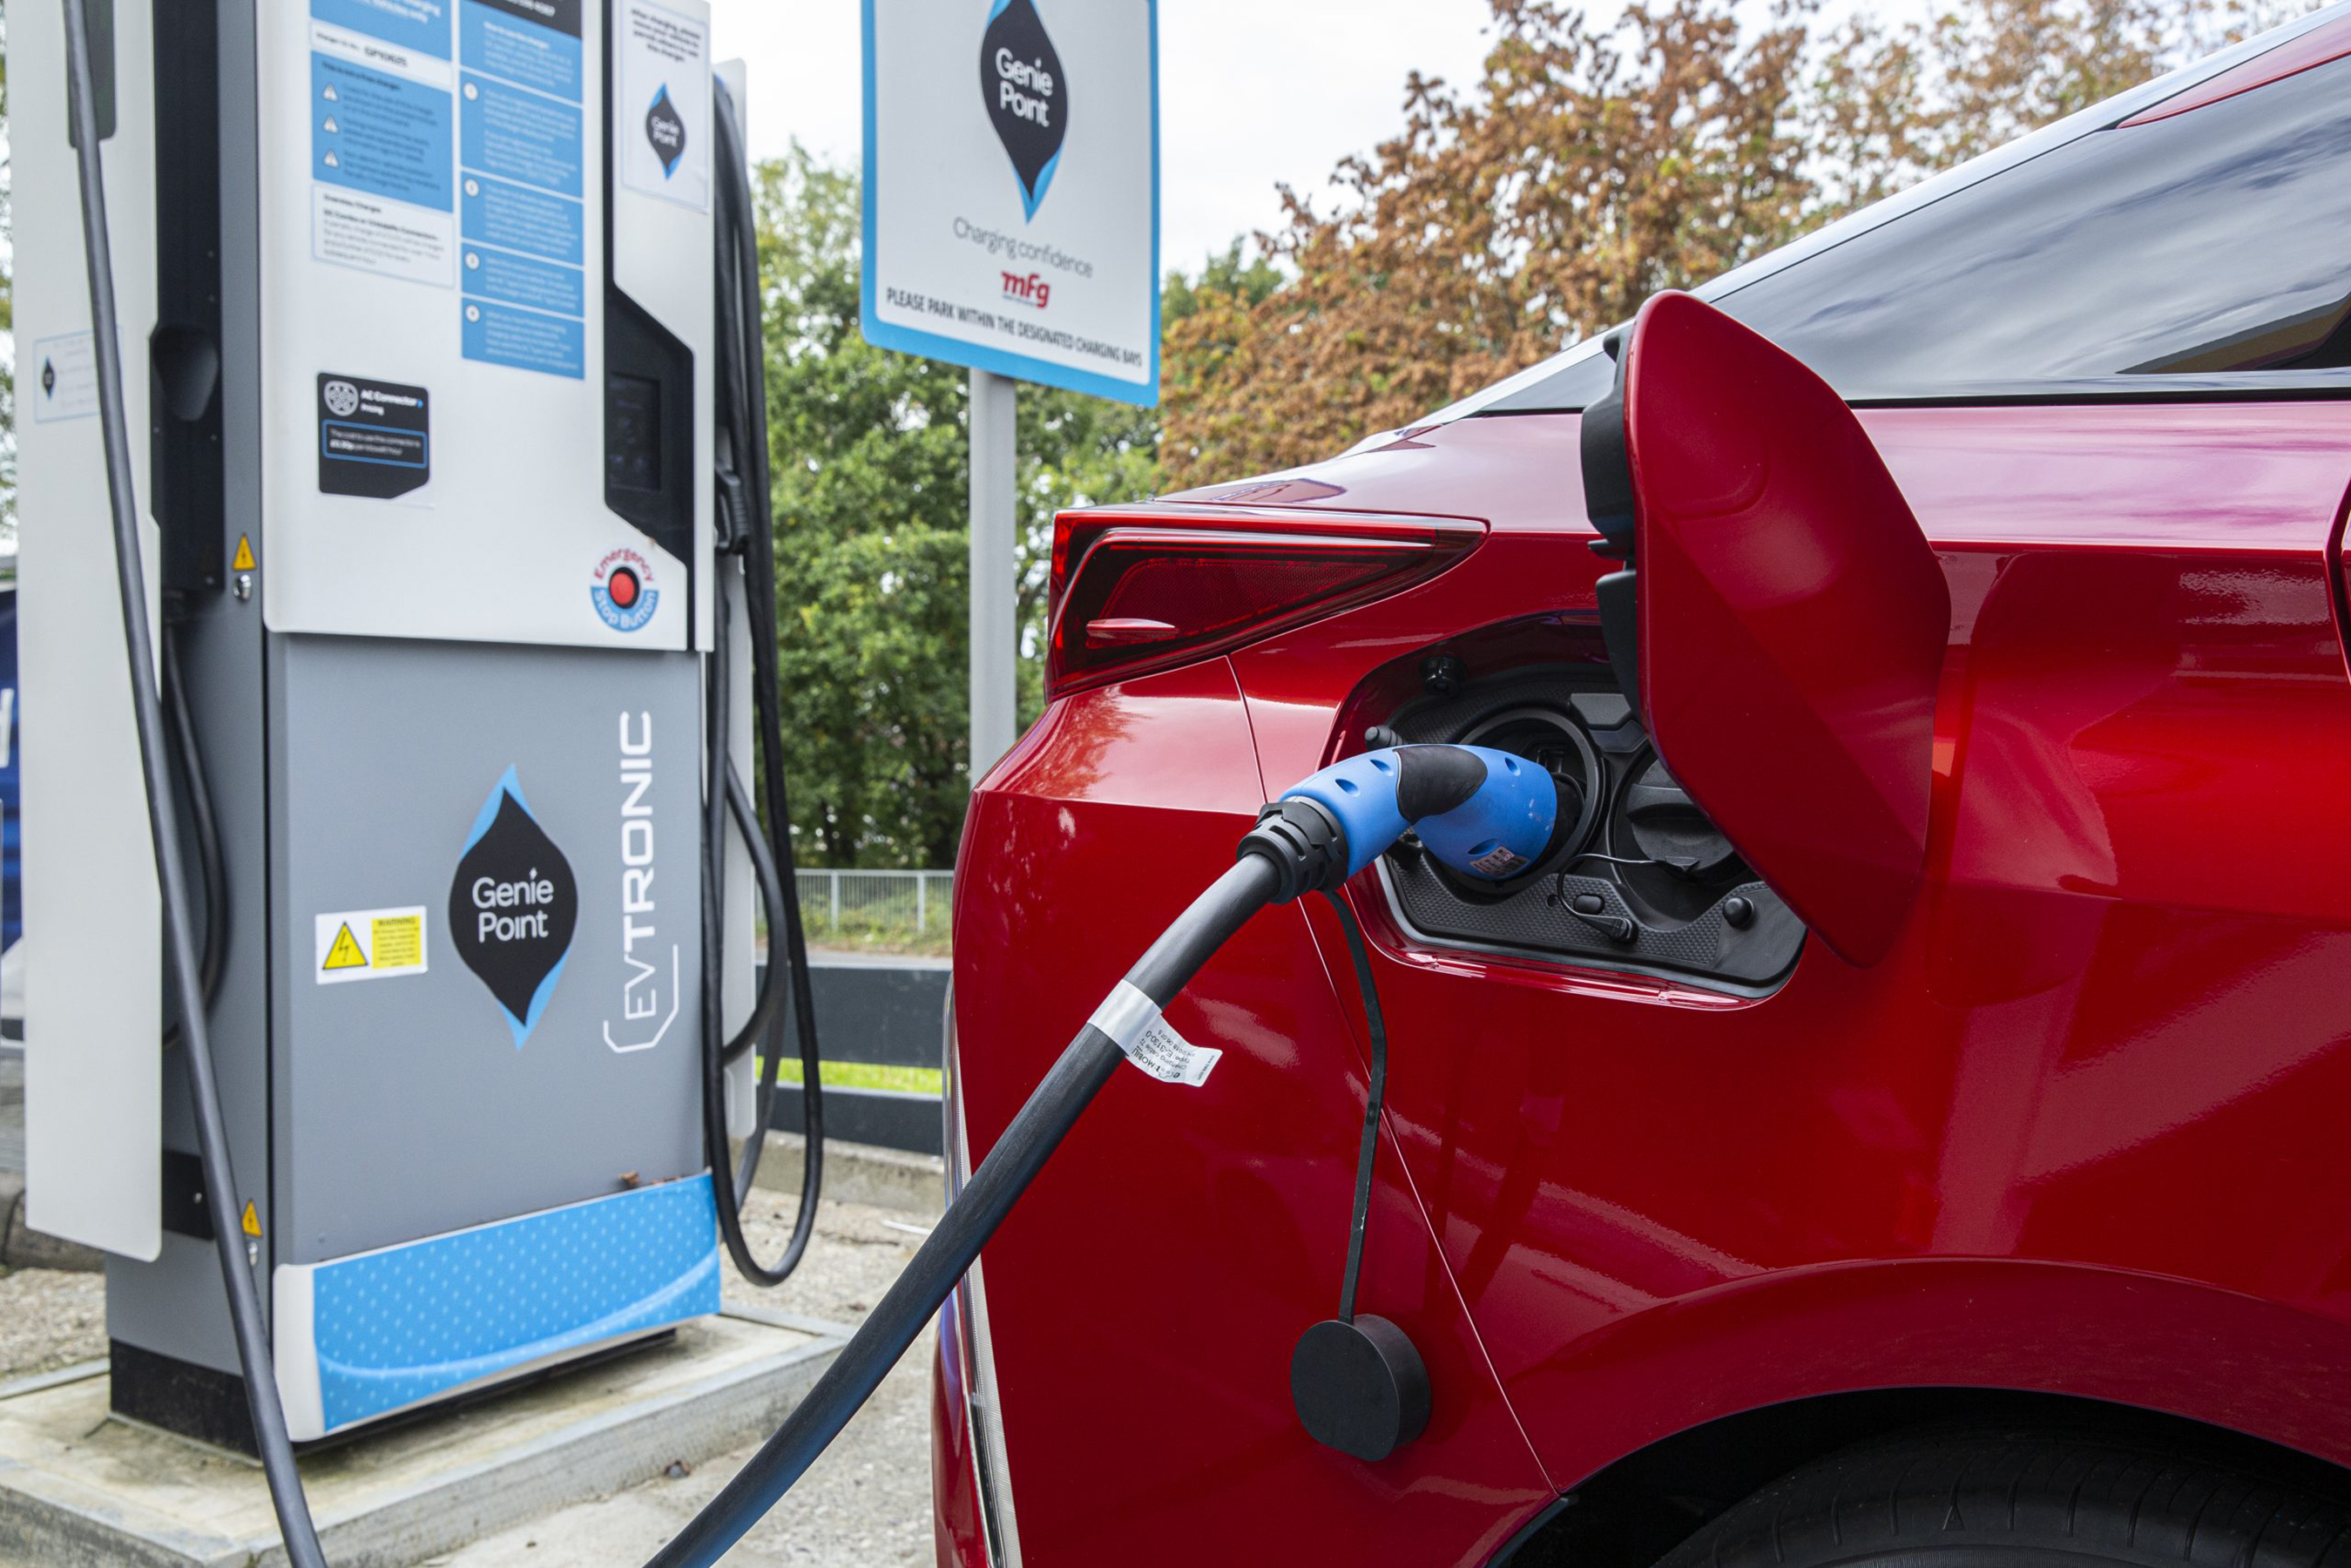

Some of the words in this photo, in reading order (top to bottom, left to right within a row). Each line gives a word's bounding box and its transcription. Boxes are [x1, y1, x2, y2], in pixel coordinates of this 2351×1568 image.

[995, 47, 1054, 97] Genie
[1000, 79, 1051, 128] Point
[651, 116, 680, 136] Genie
[953, 216, 1017, 260] Charging
[1018, 242, 1093, 279] confidence
[1001, 270, 1051, 309] mfg
[887, 287, 925, 314] PLEASE
[928, 297, 956, 321] PARK
[958, 306, 996, 328] WITHIN
[997, 316, 1016, 335] THE
[1017, 321, 1075, 349] DESIGNATED
[1076, 335, 1121, 361] CHARGING
[1122, 348, 1143, 368] BAYS
[593, 548, 654, 582] Emergency
[594, 589, 619, 625] Stop
[620, 591, 656, 628] Button
[619, 710, 657, 1020] EVTRONIC
[471, 867, 554, 909] Genie
[478, 909, 549, 943] Point
